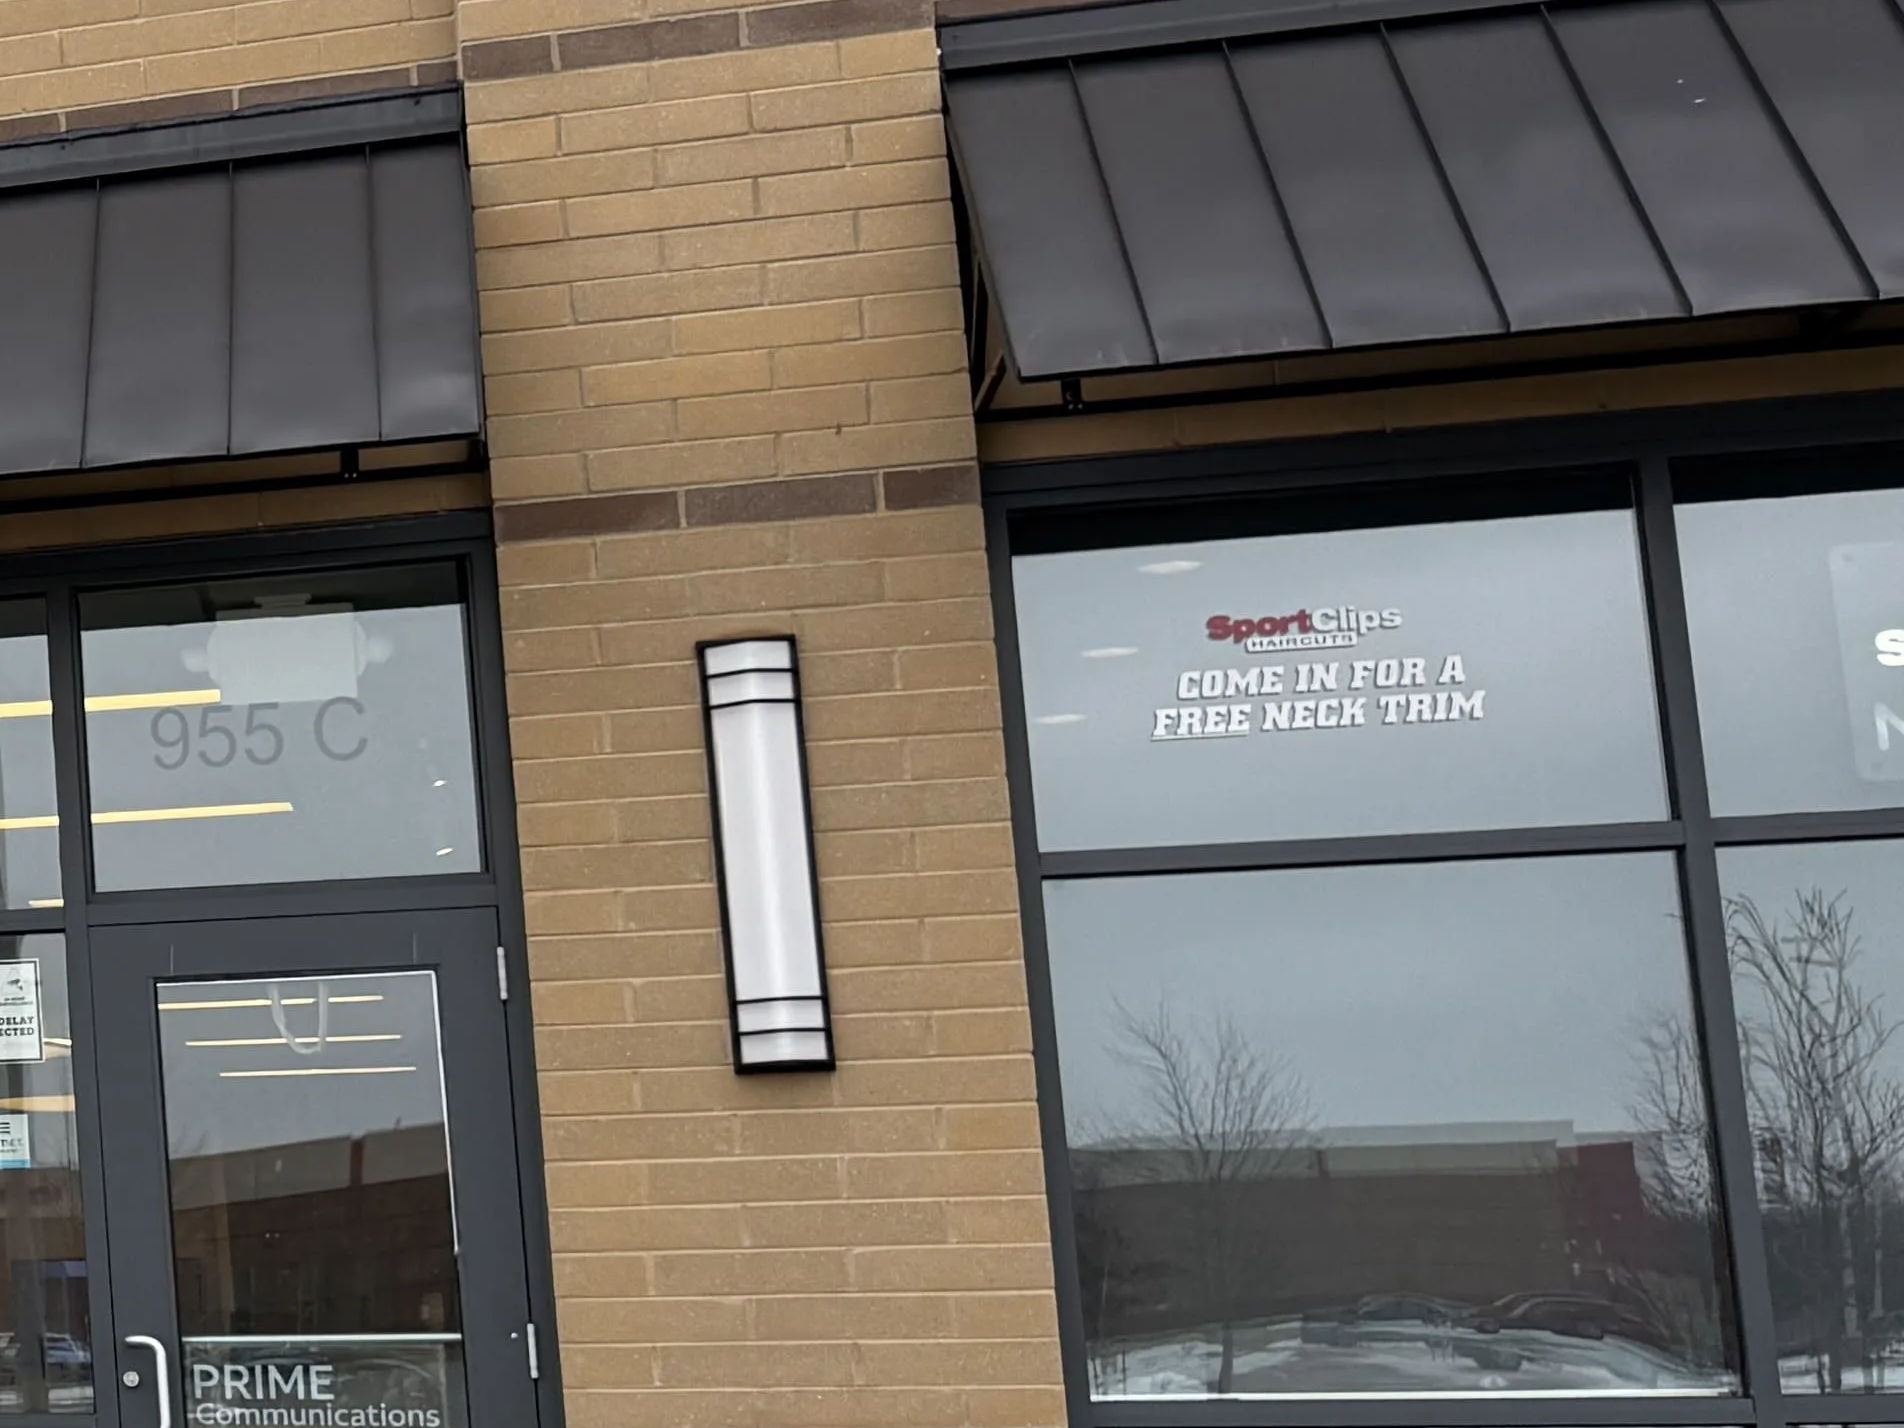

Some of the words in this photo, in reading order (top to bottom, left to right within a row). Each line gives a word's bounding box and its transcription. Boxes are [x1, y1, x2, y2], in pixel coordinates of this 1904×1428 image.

[1251, 634, 1353, 649] HAIRCUTS
[1177, 665, 1285, 700] COME
[1294, 662, 1339, 693] IN
[1349, 657, 1426, 689] FOR
[1437, 654, 1466, 685] A
[151, 702, 284, 770] 955
[314, 696, 368, 762] C
[1152, 704, 1251, 738] FREE
[1260, 696, 1367, 731] NECK
[1378, 689, 1486, 724] TRIM
[192, 1364, 335, 1400] PRIME
[196, 1403, 441, 1428] Communications
